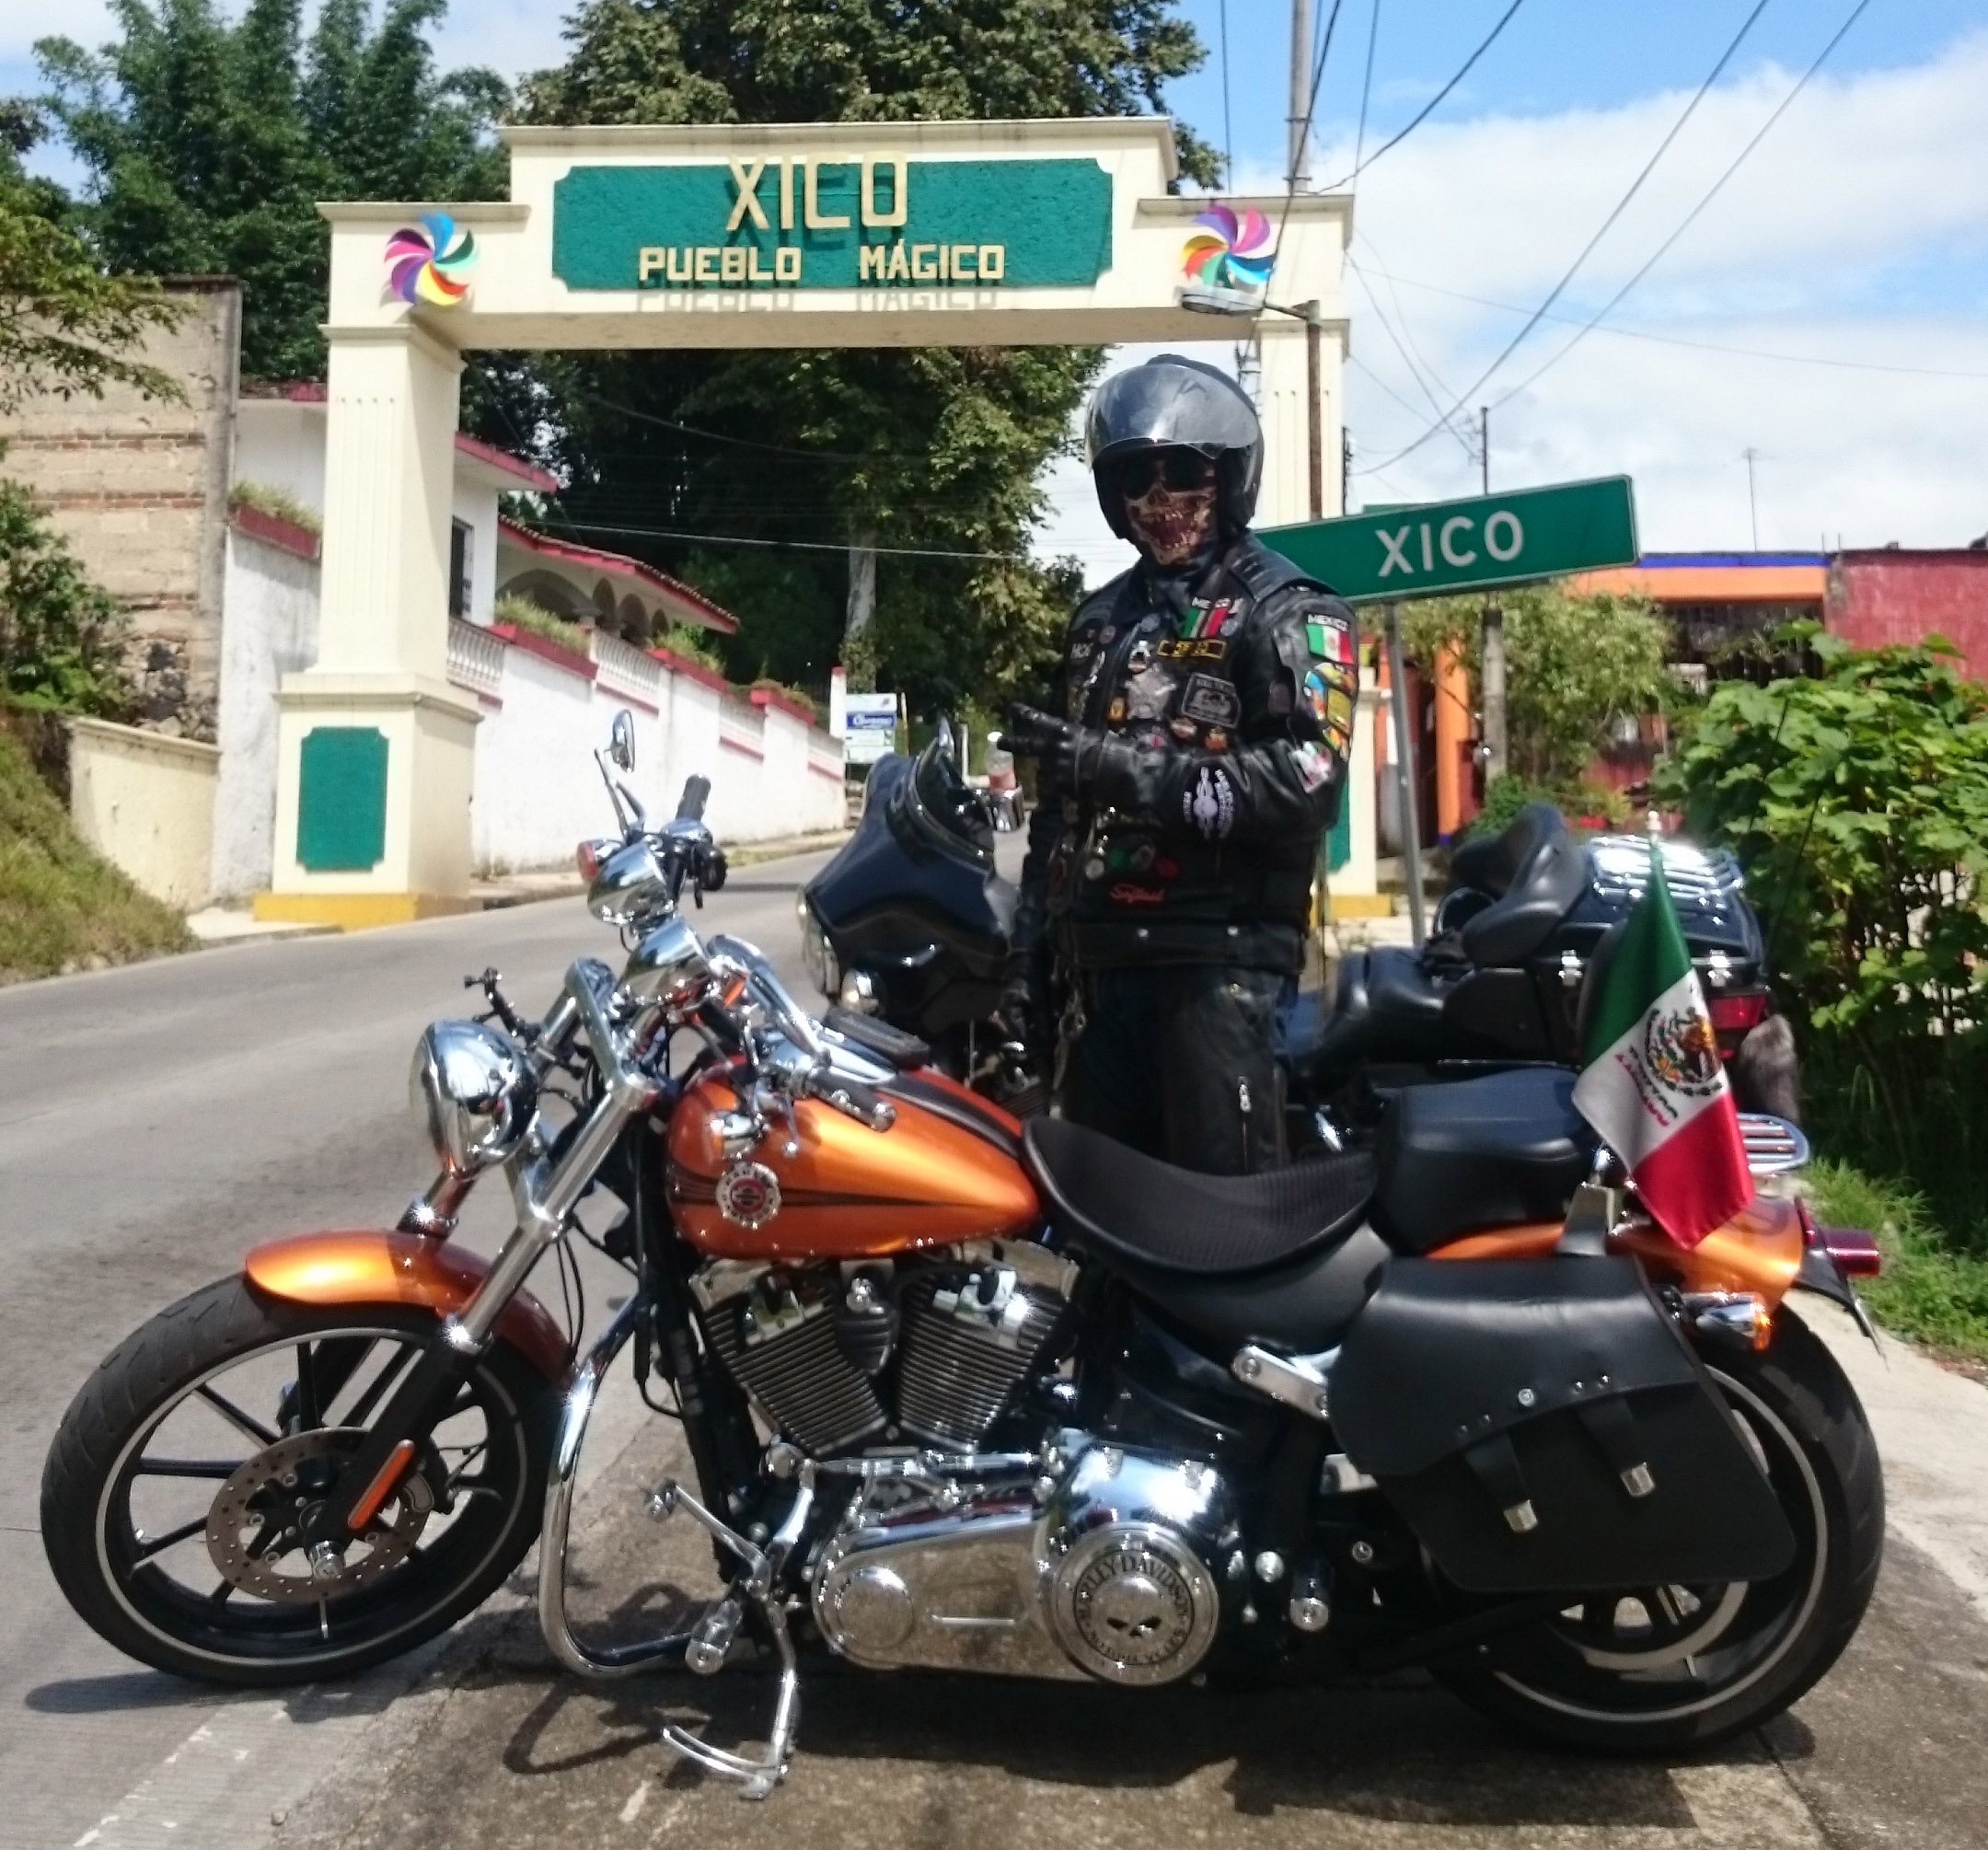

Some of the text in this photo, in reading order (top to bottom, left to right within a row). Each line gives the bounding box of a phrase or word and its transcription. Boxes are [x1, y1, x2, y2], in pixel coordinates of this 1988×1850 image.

[726, 151, 908, 230] XICO
[639, 238, 1005, 281] PUEBLO MÁGICO
[1375, 510, 1524, 577] XICO
